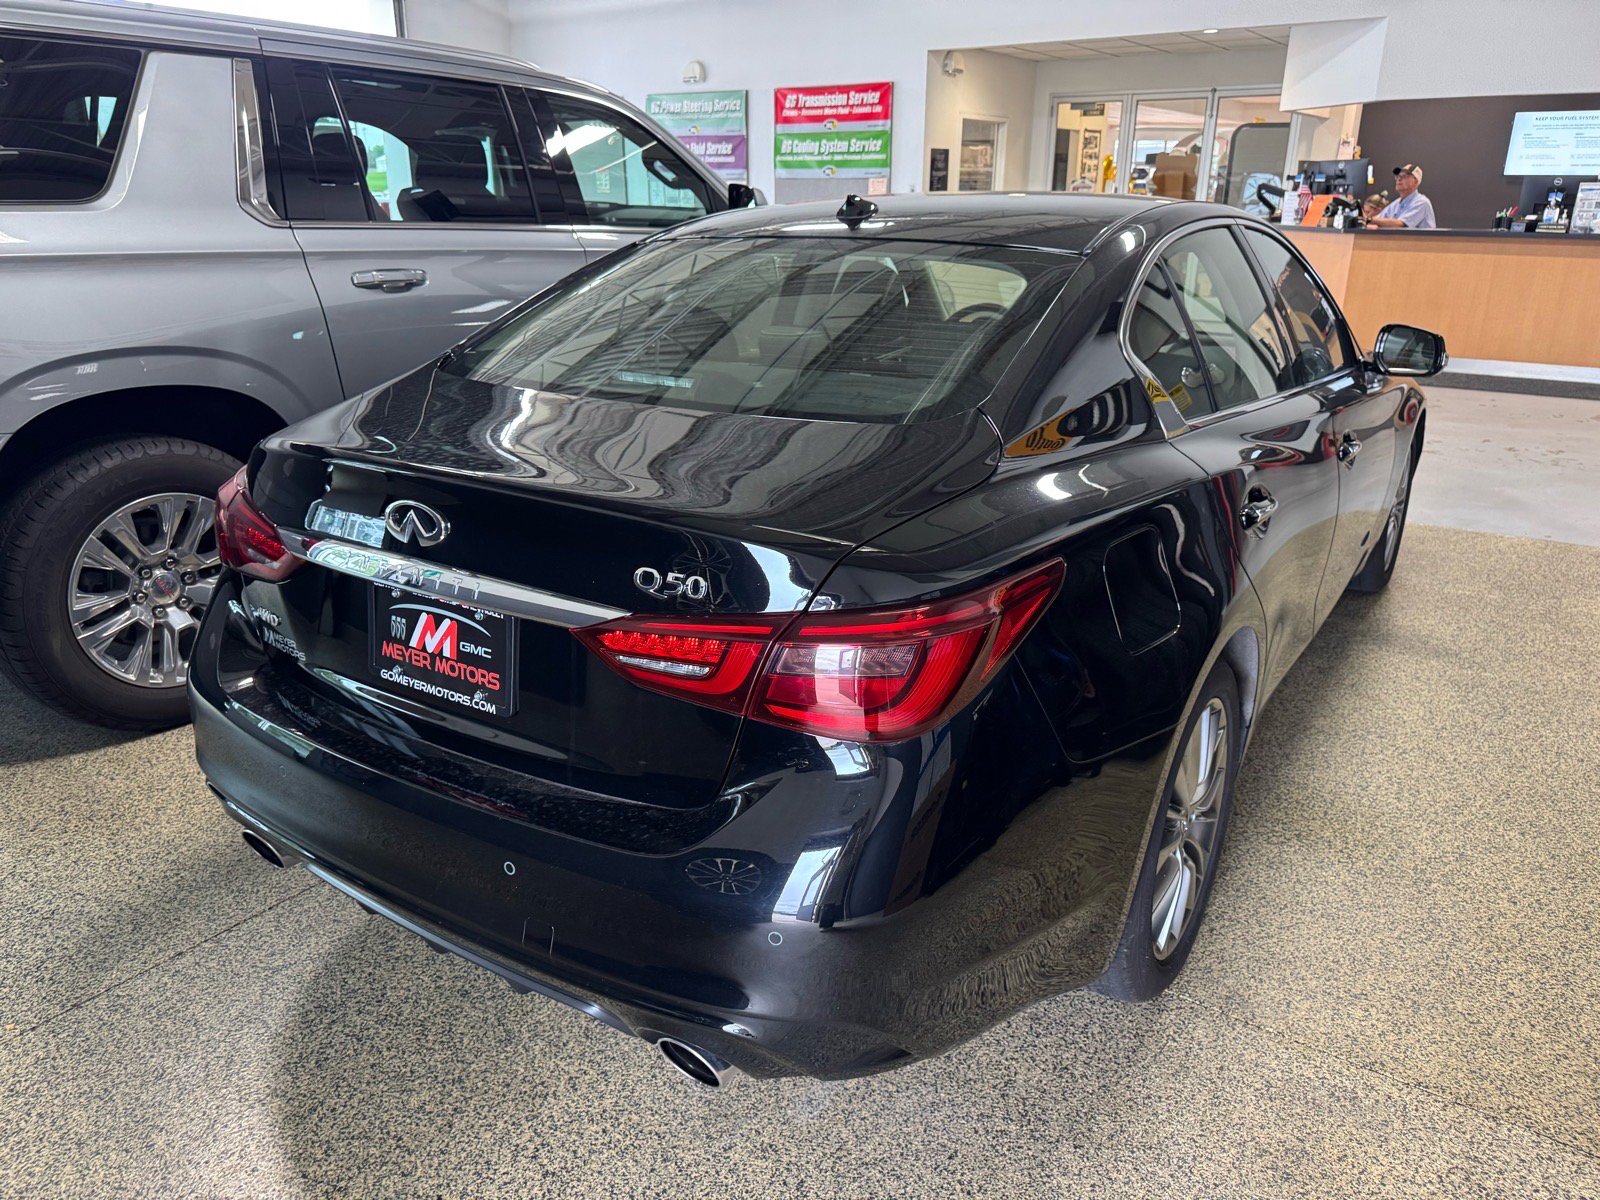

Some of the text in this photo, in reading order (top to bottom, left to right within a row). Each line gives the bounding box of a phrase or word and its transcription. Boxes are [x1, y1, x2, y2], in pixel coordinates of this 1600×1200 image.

[682, 100, 713, 113] Steering
[714, 99, 741, 111] Service
[798, 93, 847, 107] Transmission
[849, 91, 880, 104] Service
[706, 141, 733, 155] Service
[792, 140, 819, 155] Cooling
[820, 139, 849, 155] System
[850, 138, 882, 152] Service
[633, 566, 708, 600] Q50
[460, 641, 493, 659] GMC
[381, 640, 501, 692] MEYER MOTORS
[380, 668, 498, 716] GOMEYERMOTORS.COM
